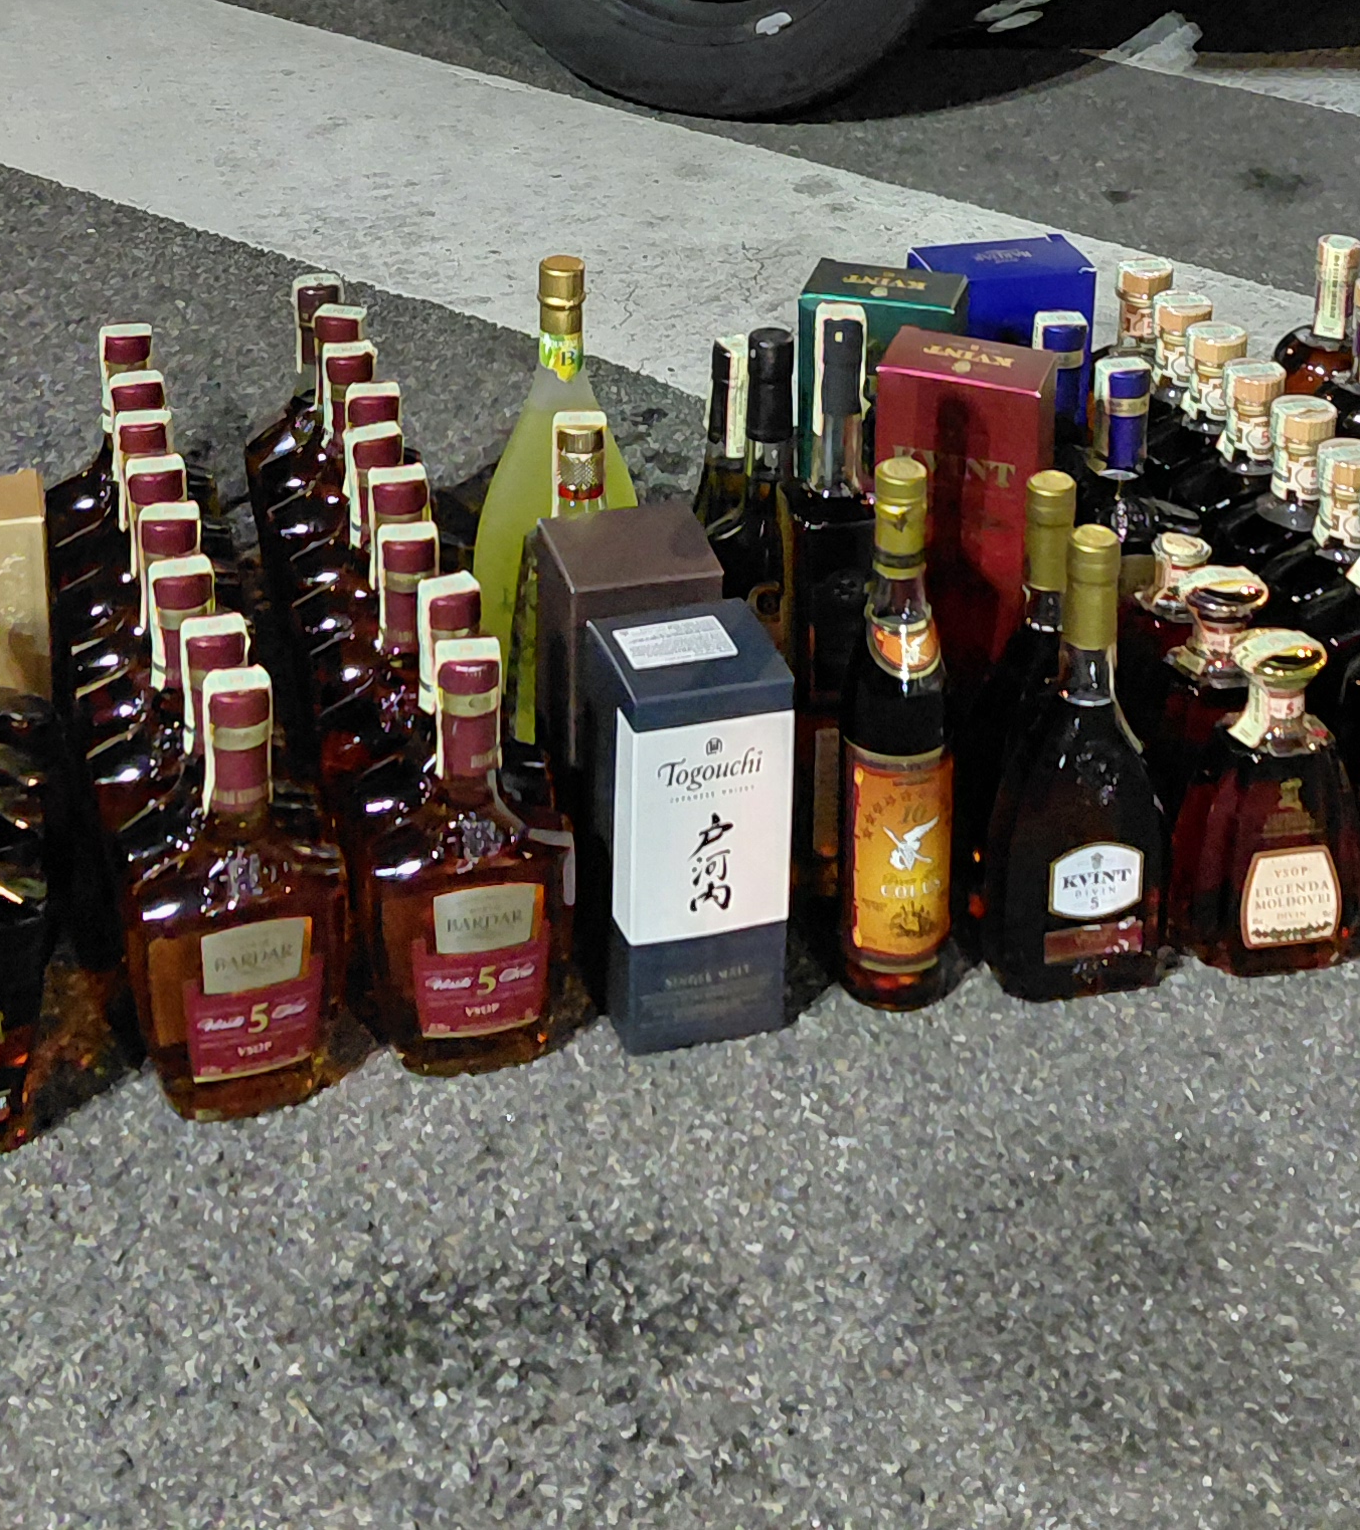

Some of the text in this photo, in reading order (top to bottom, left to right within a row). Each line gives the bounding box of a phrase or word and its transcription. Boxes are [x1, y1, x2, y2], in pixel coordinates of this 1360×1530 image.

[842, 273, 928, 292] KVINT
[922, 344, 1015, 369] KVINT
[657, 746, 763, 792] Togouchi
[1062, 867, 1133, 890] KVINT
[1273, 866, 1309, 879] VSOP
[1255, 879, 1330, 898] LEGENDA
[1089, 896, 1100, 910] 5
[1254, 892, 1331, 911] MOLDOVEI
[446, 908, 523, 933] BARDAR
[476, 964, 497, 996] 5
[247, 1001, 270, 1034] 5
